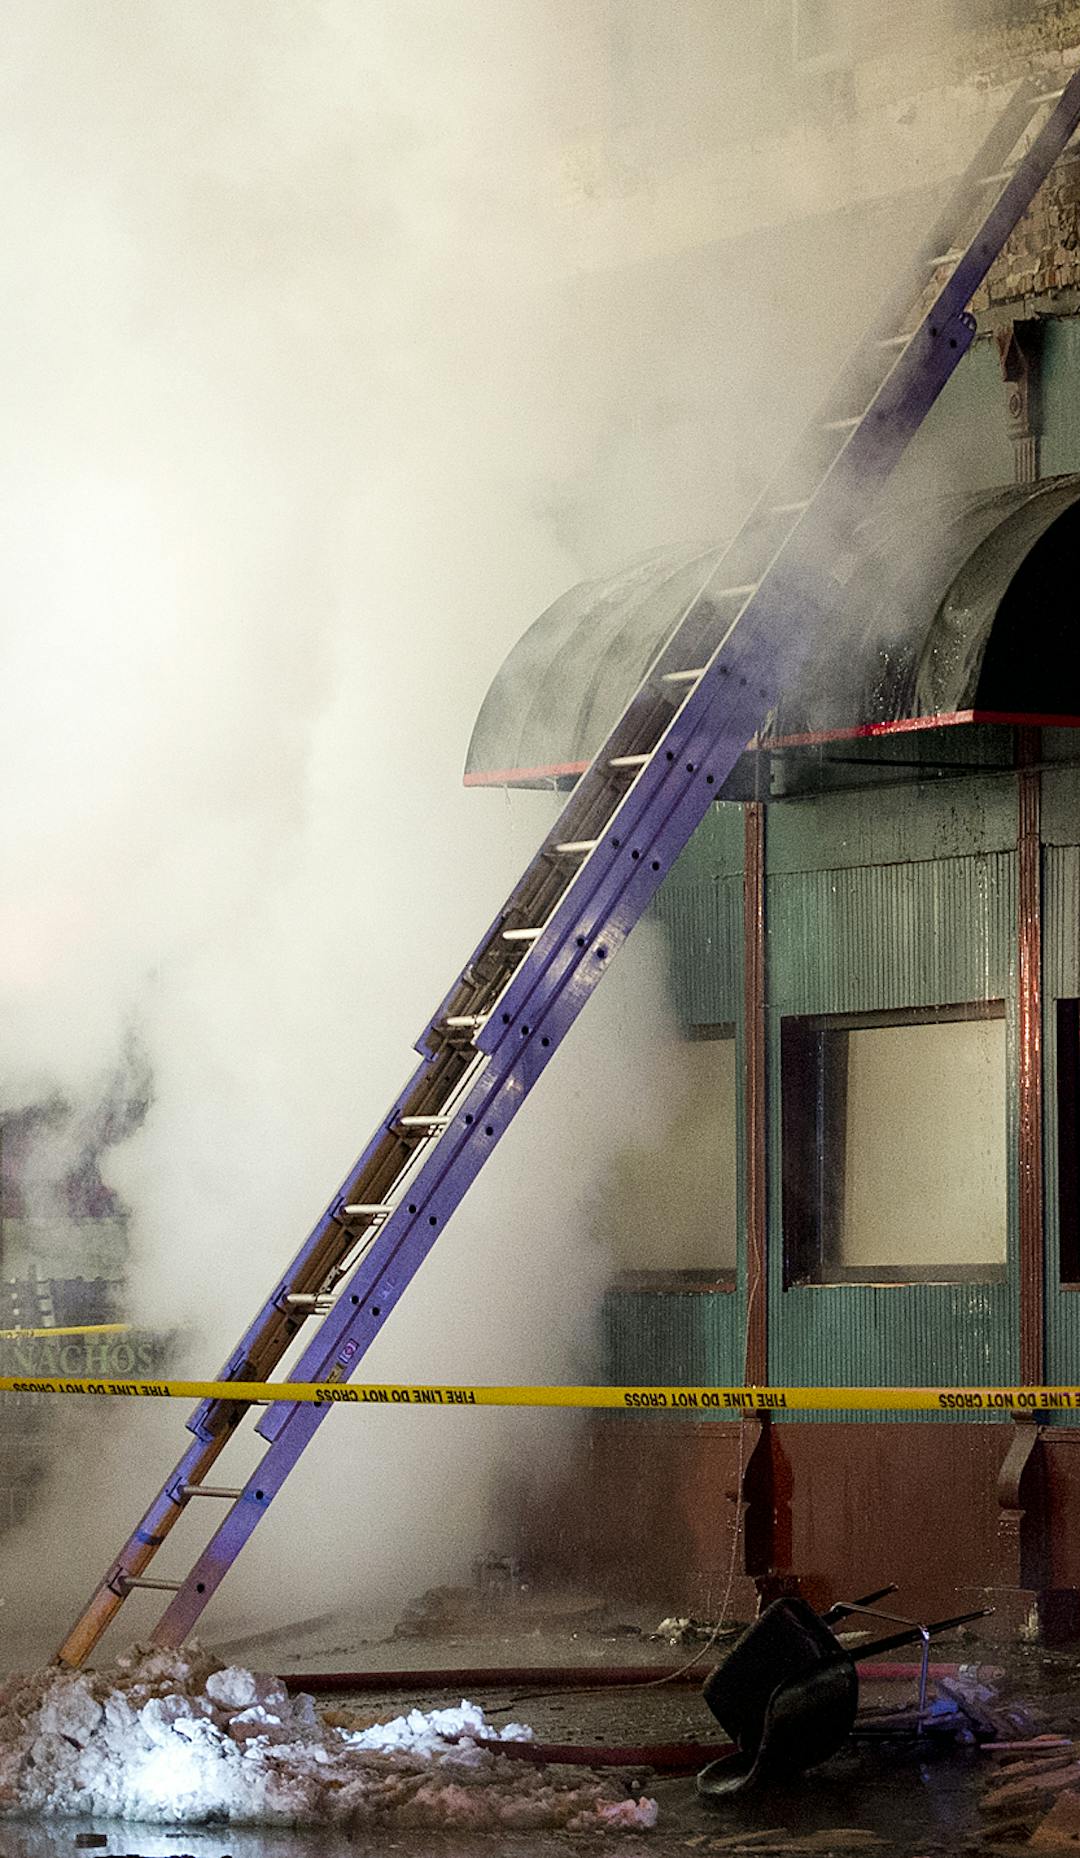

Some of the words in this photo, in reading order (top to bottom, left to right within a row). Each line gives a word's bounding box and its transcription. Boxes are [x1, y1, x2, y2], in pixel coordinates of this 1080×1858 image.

[13, 1343, 156, 1376] NACHOS
[13, 1383, 57, 1393] CROSS
[59, 1383, 85, 1394] NOT
[88, 1384, 107, 1395] DO
[109, 1385, 140, 1396] LINE
[142, 1386, 170, 1396] FIRE
[315, 1388, 359, 1401] CROSS
[362, 1389, 387, 1402] NOT
[391, 1389, 410, 1402] DO
[412, 1390, 444, 1403] LINE
[446, 1390, 476, 1404] FIRE
[624, 1393, 667, 1407] CROSS
[671, 1393, 698, 1407] NOT
[701, 1393, 720, 1407] DO
[722, 1393, 753, 1407] LINE
[756, 1393, 787, 1407] FIRE
[938, 1393, 983, 1408] CROSS
[986, 1393, 1014, 1408] NOT
[1017, 1393, 1037, 1407] DO
[1040, 1392, 1071, 1407] LINE
